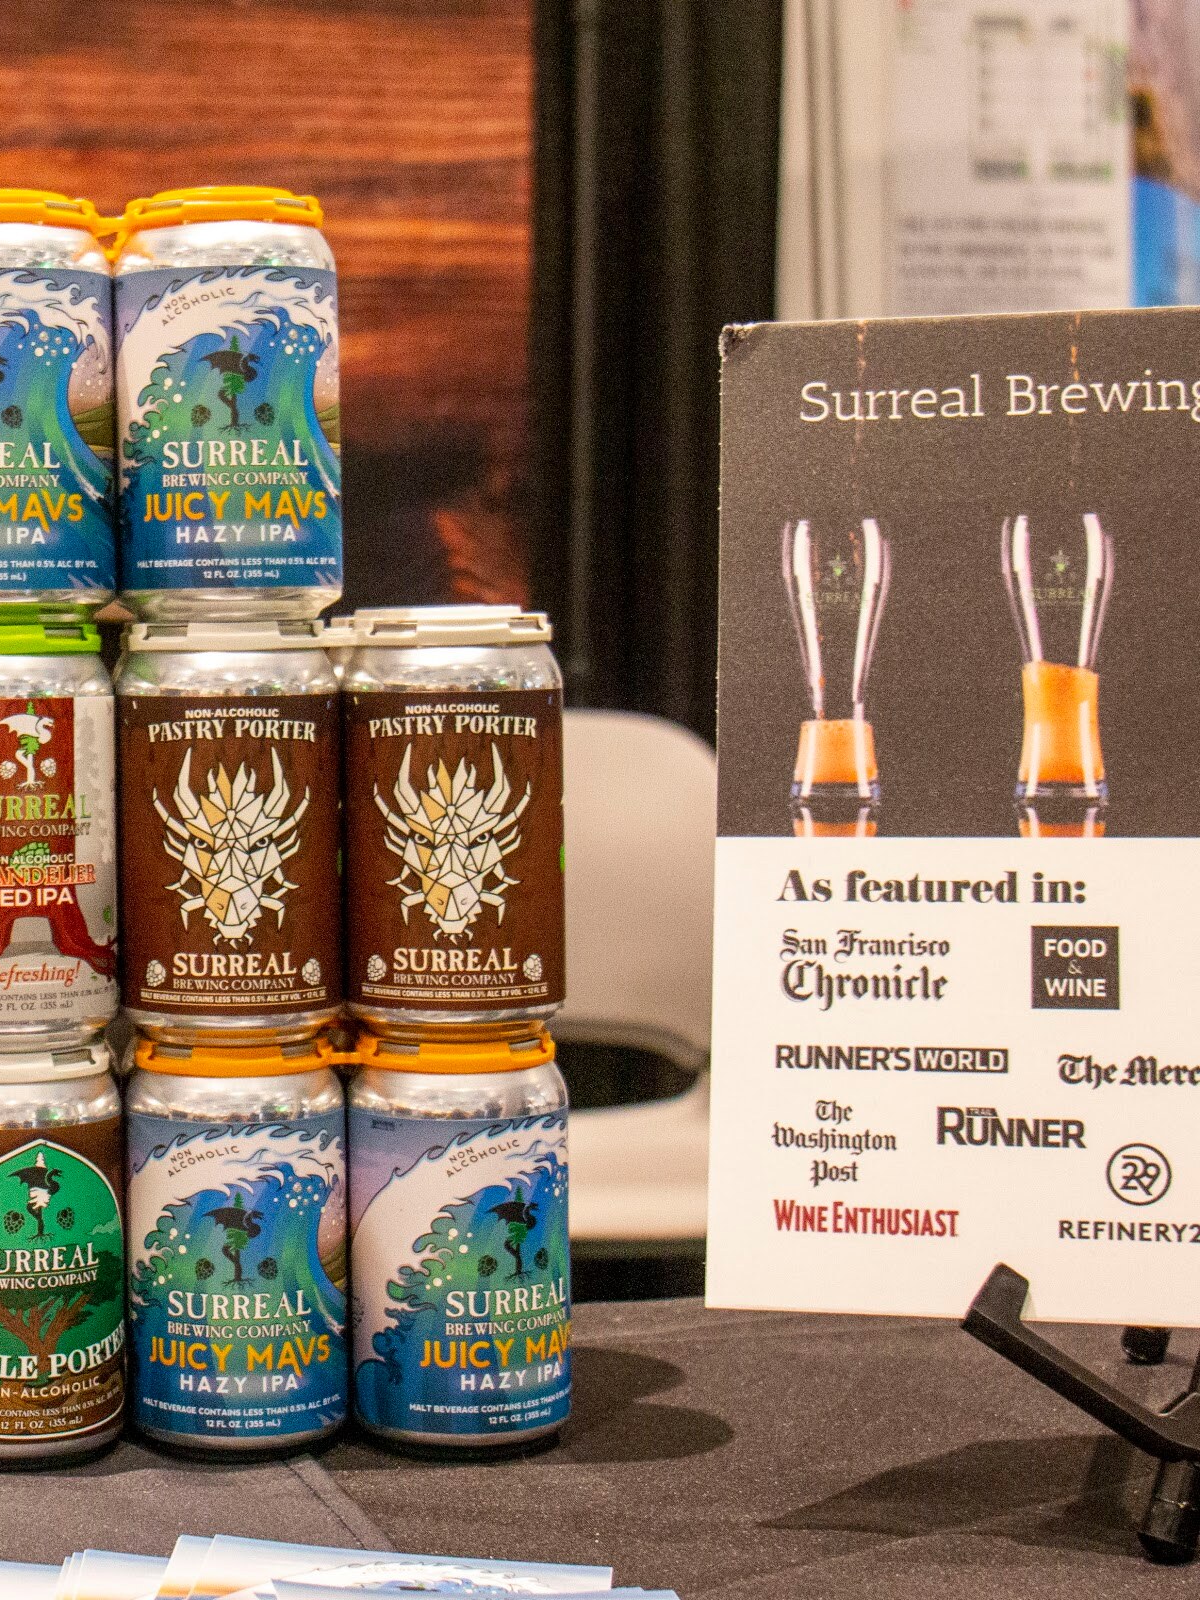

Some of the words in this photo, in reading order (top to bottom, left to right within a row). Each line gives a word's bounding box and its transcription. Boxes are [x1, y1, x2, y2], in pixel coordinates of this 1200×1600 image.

[162, 288, 235, 326] ALCOHOLIC
[164, 294, 186, 311] NON
[800, 374, 985, 421] Surreal
[162, 439, 308, 469] SURREAL
[163, 473, 230, 488] BREWING
[234, 472, 308, 485] COMPANY
[144, 491, 231, 522] JUICY
[245, 487, 328, 530] MAVS
[6, 528, 45, 545] IPA
[176, 526, 245, 544] HAZY
[261, 524, 296, 541] IPA
[242, 558, 262, 566] LESS
[185, 708, 280, 718] NON-ALCOHOLIC
[405, 704, 500, 714] NON-ALCOHOLIC
[148, 719, 226, 742] PASTRY
[235, 720, 315, 742] PORTER
[369, 715, 446, 738] PASTRY
[455, 715, 536, 738] PORTER
[30, 822, 91, 837] COMPANY
[12, 853, 74, 864] ALCOHOLIC
[37, 887, 74, 905] IPA
[775, 870, 832, 902] As
[844, 870, 1020, 903] featured
[1031, 872, 1087, 904] in:
[780, 929, 827, 962] San
[834, 929, 951, 963] Francisco
[1044, 939, 1107, 958] FOOD
[173, 952, 297, 976] SURREAL
[393, 948, 517, 972] SURREAL
[1068, 960, 1083, 974] &
[173, 979, 228, 991] BREWING
[231, 977, 295, 990] COMPANY
[393, 974, 449, 985] BREWING
[451, 974, 515, 985] COMPANY
[781, 960, 948, 1011] Chronicle
[1045, 978, 1106, 998] WINE
[775, 1045, 911, 1071] RUNNER'S
[917, 1050, 1006, 1072] WORLD
[1058, 1054, 1117, 1089] The
[815, 1099, 853, 1124] The
[937, 1106, 1087, 1148] RUNNER
[771, 1122, 897, 1156] Washington
[168, 1146, 240, 1177] ALCOHOLIC
[170, 1149, 191, 1163] NON
[445, 1139, 520, 1178] ALCOHOLIC
[450, 1147, 475, 1163] NON
[809, 1160, 859, 1188] Post
[773, 1199, 828, 1233] WINE
[833, 1202, 960, 1238] ENTHUSIAST
[38, 1270, 98, 1288] COMPANY
[167, 1290, 311, 1320] SURREAL
[446, 1277, 567, 1318] SURREAL
[167, 1321, 233, 1338] BREWING
[237, 1320, 311, 1338] COMPANY
[446, 1322, 515, 1336] BREWING
[517, 1309, 567, 1331] COMPANY
[150, 1336, 233, 1371] JUICY
[247, 1334, 331, 1377] MAVS
[420, 1338, 515, 1369] JUICY
[180, 1374, 248, 1394] HAZY
[263, 1374, 298, 1393] IPA
[461, 1370, 527, 1391] HAZY
[537, 1361, 561, 1383] IPA
[0, 1408, 40, 1417] CONTAINS
[199, 1408, 240, 1416] CONTAINS
[266, 1407, 287, 1415] THAN
[434, 1405, 479, 1413] BEVERAGE
[481, 1403, 521, 1412] CONTAINS
